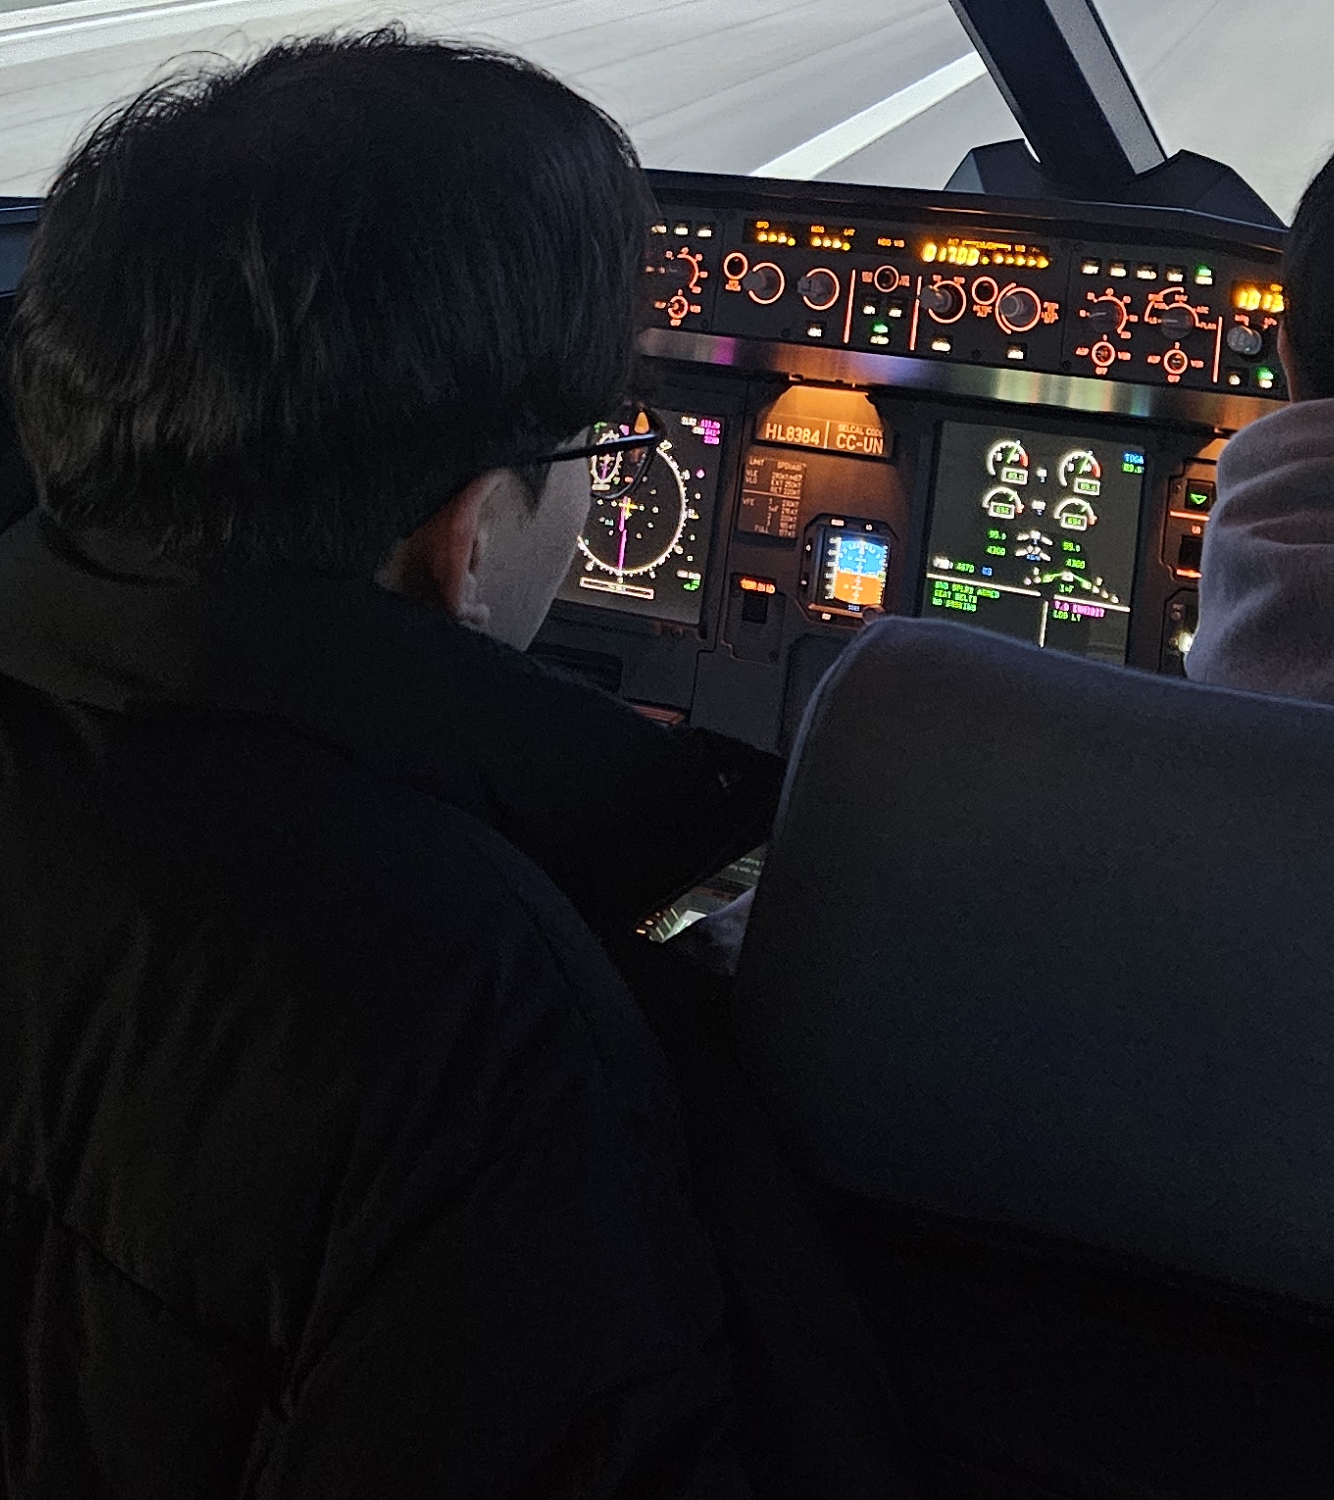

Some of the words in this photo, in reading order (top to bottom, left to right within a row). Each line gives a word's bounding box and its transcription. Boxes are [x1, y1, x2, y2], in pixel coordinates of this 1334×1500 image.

[765, 422, 820, 445] HL8384
[838, 424, 864, 436] SELCAL
[836, 434, 884, 455] CC-UN
